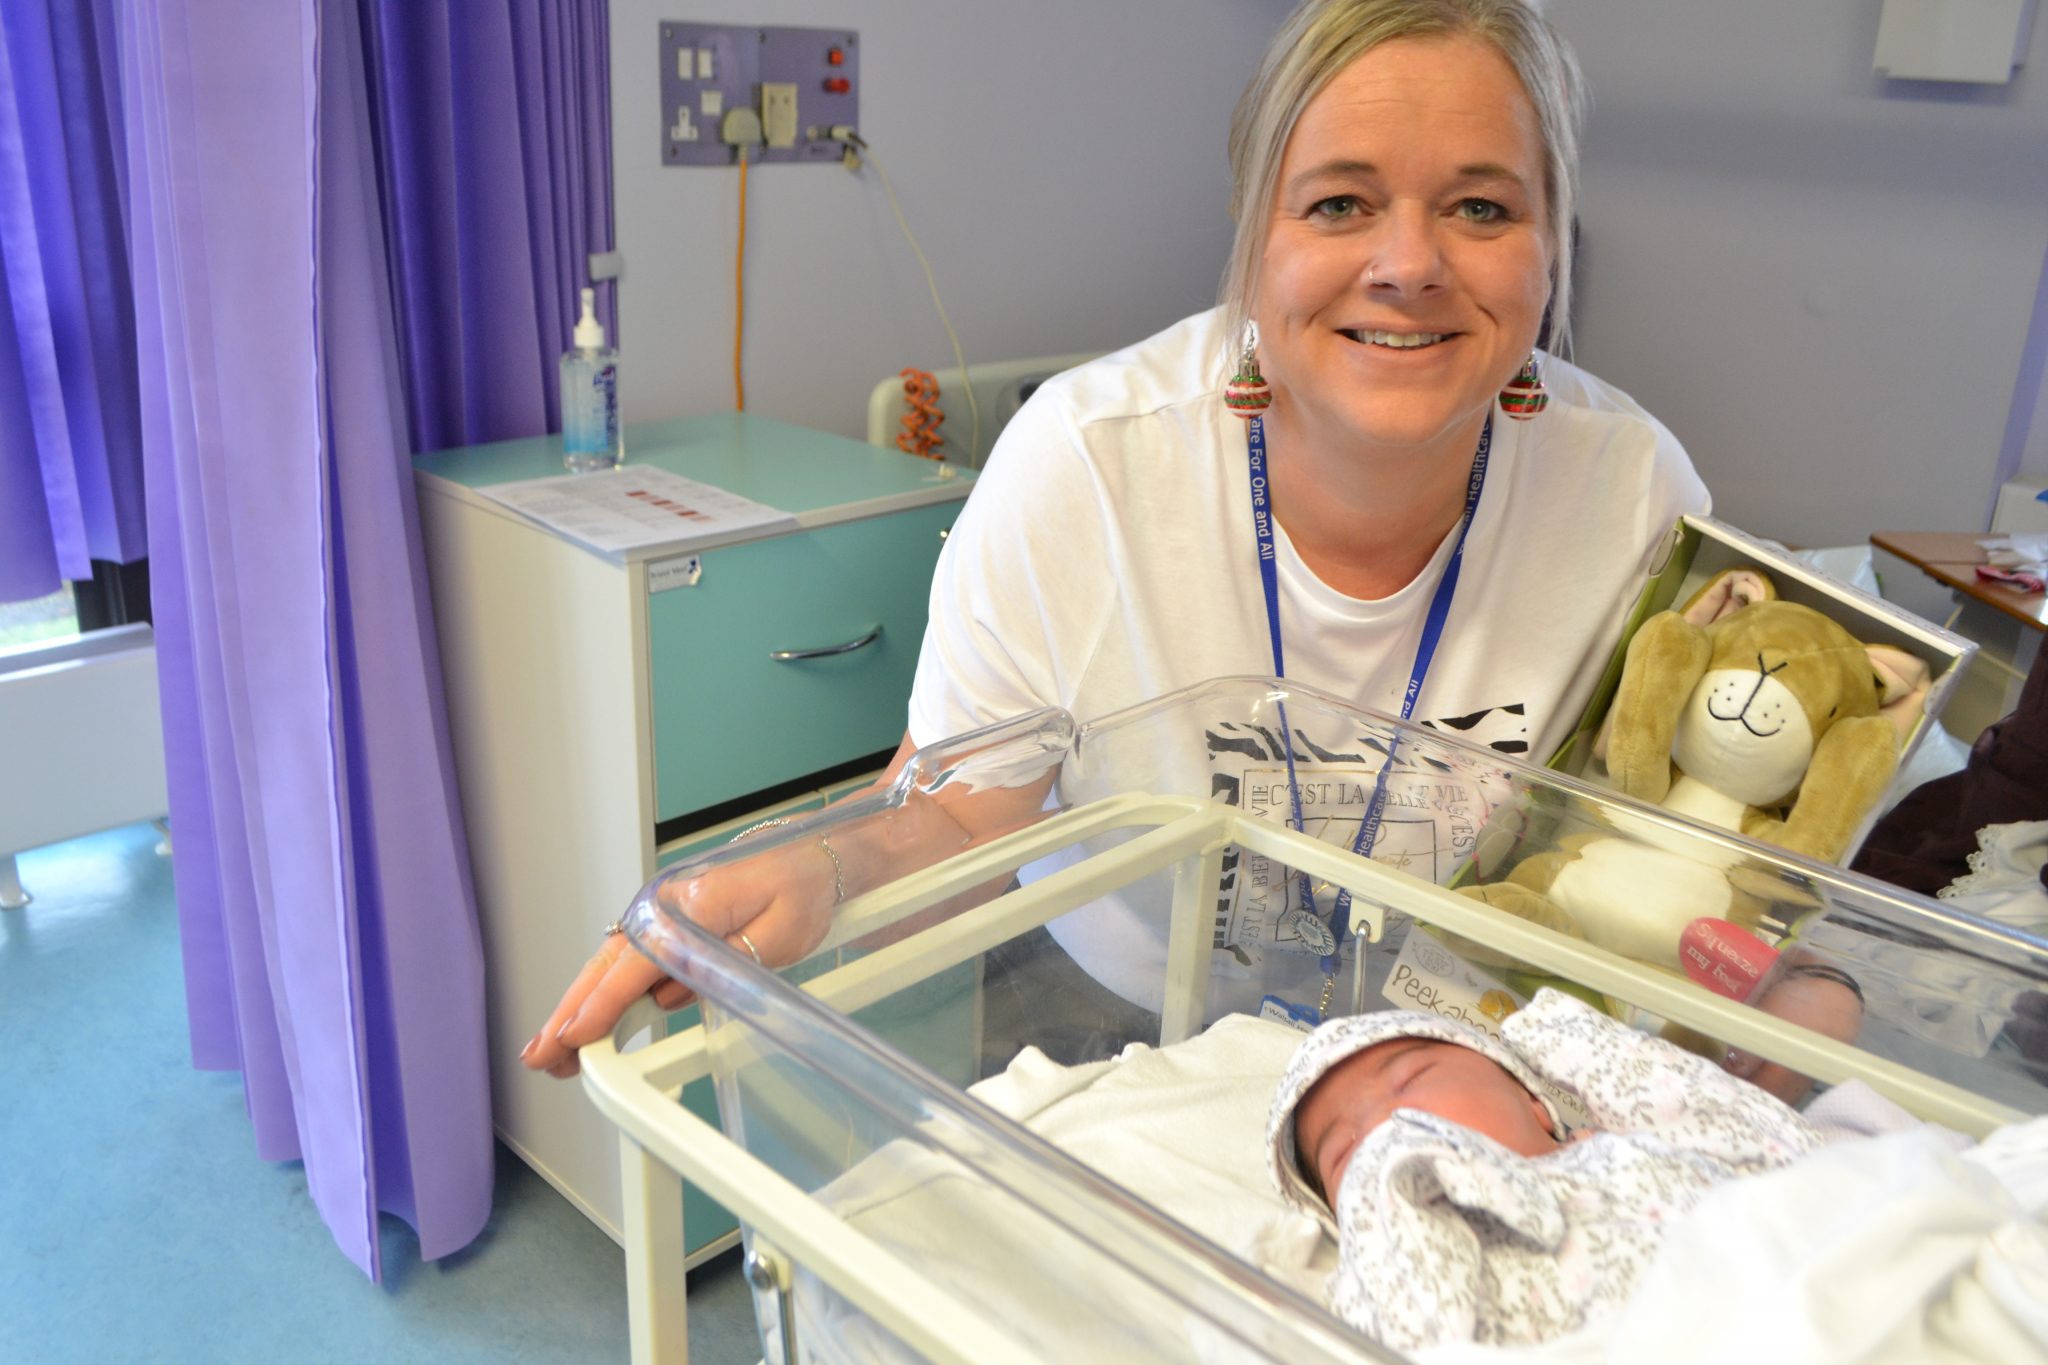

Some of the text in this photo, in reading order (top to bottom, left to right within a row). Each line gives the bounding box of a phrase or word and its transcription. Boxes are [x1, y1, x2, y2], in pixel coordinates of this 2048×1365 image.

[1250, 415, 1274, 560] are For One and All
[1408, 679, 1419, 698] All
[1337, 783, 1365, 804] LA
[1435, 783, 1469, 803] VIE
[1687, 946, 1711, 971] my
[1696, 923, 1758, 978] Squeeze
